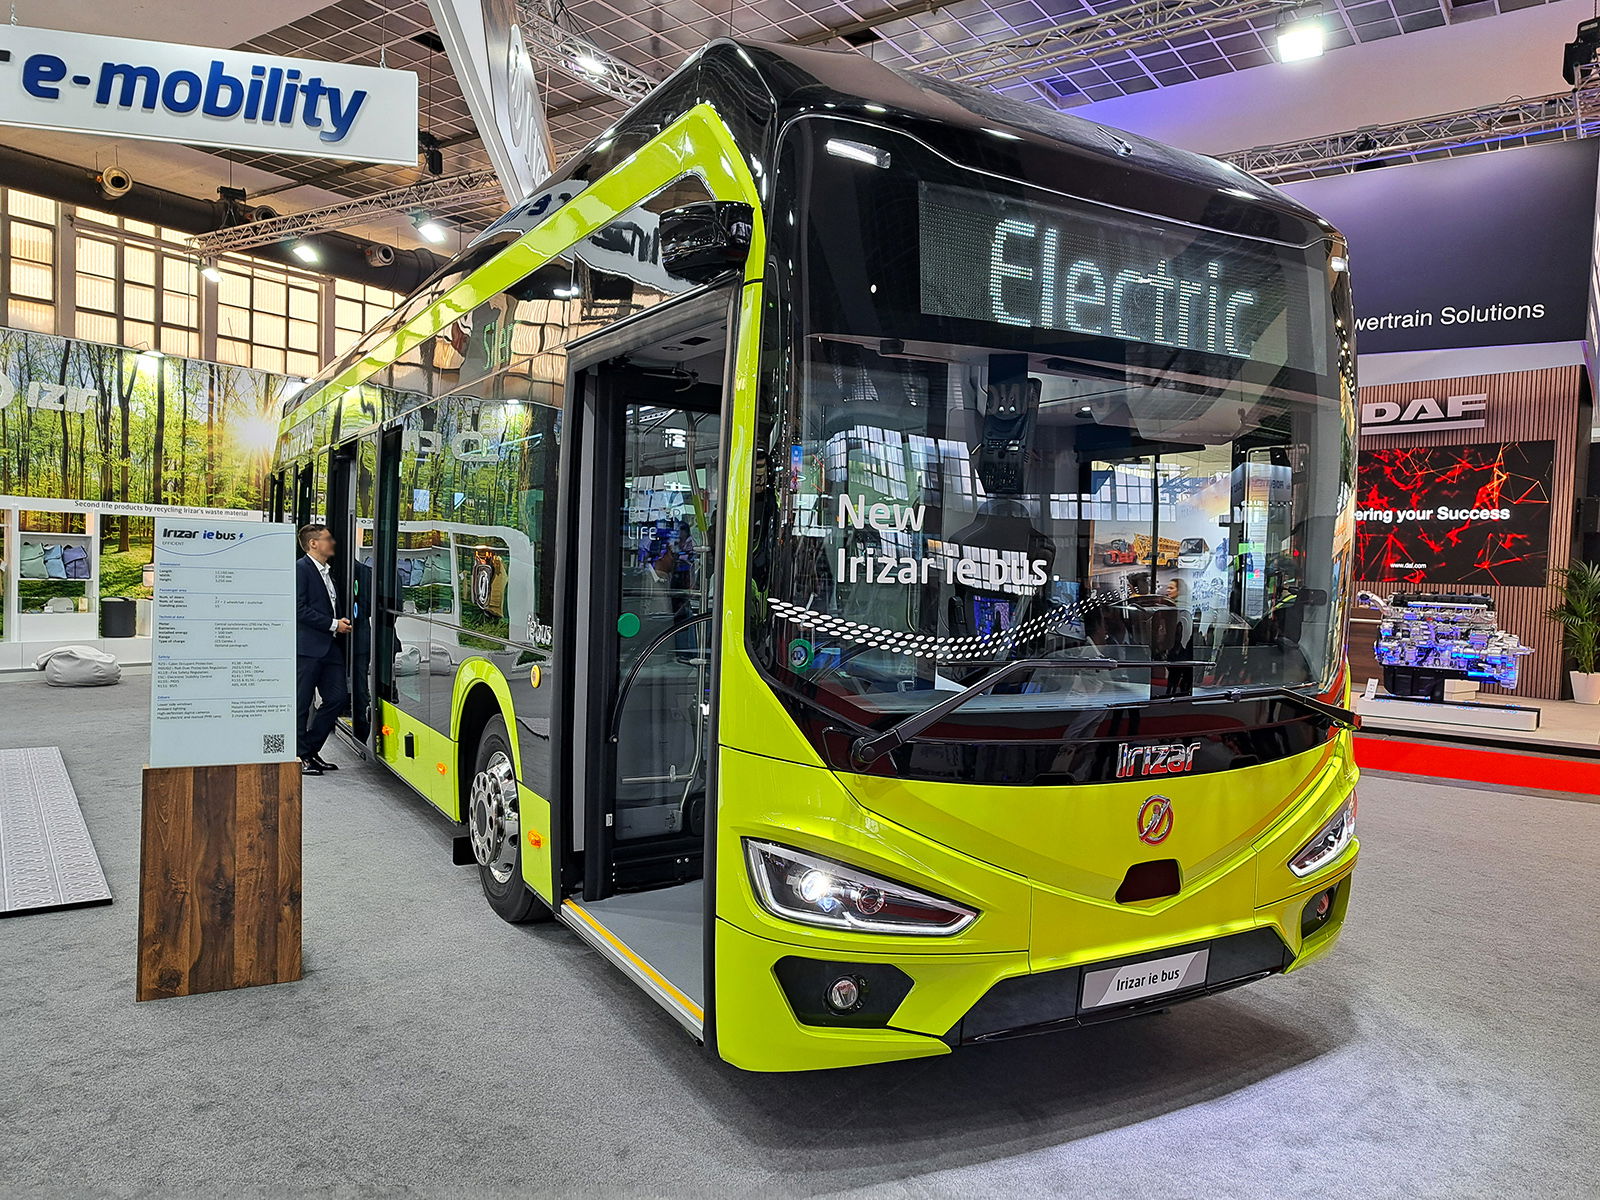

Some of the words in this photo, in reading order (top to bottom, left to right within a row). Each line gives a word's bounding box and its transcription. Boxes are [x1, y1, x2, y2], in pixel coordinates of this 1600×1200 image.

[22, 53, 368, 143] e-mobility
[988, 217, 1255, 359] Electric
[1440, 302, 1545, 325] Solutions
[1361, 393, 1487, 424] DAF
[74, 500, 100, 508] Second
[114, 504, 143, 512] products
[144, 505, 153, 513] by
[154, 506, 183, 514] recycling
[838, 493, 926, 532] New
[1396, 508, 1433, 522] your
[1437, 506, 1511, 521] Success
[162, 528, 199, 539] Irizar
[628, 526, 660, 541] LIFE.
[837, 548, 936, 585] Irizar
[945, 549, 976, 586] ie
[989, 550, 1048, 586] bus
[1115, 742, 1201, 778] Irizar
[1116, 976, 1146, 992] Irizar
[1148, 972, 1158, 986] ie
[1160, 968, 1180, 983] bus
